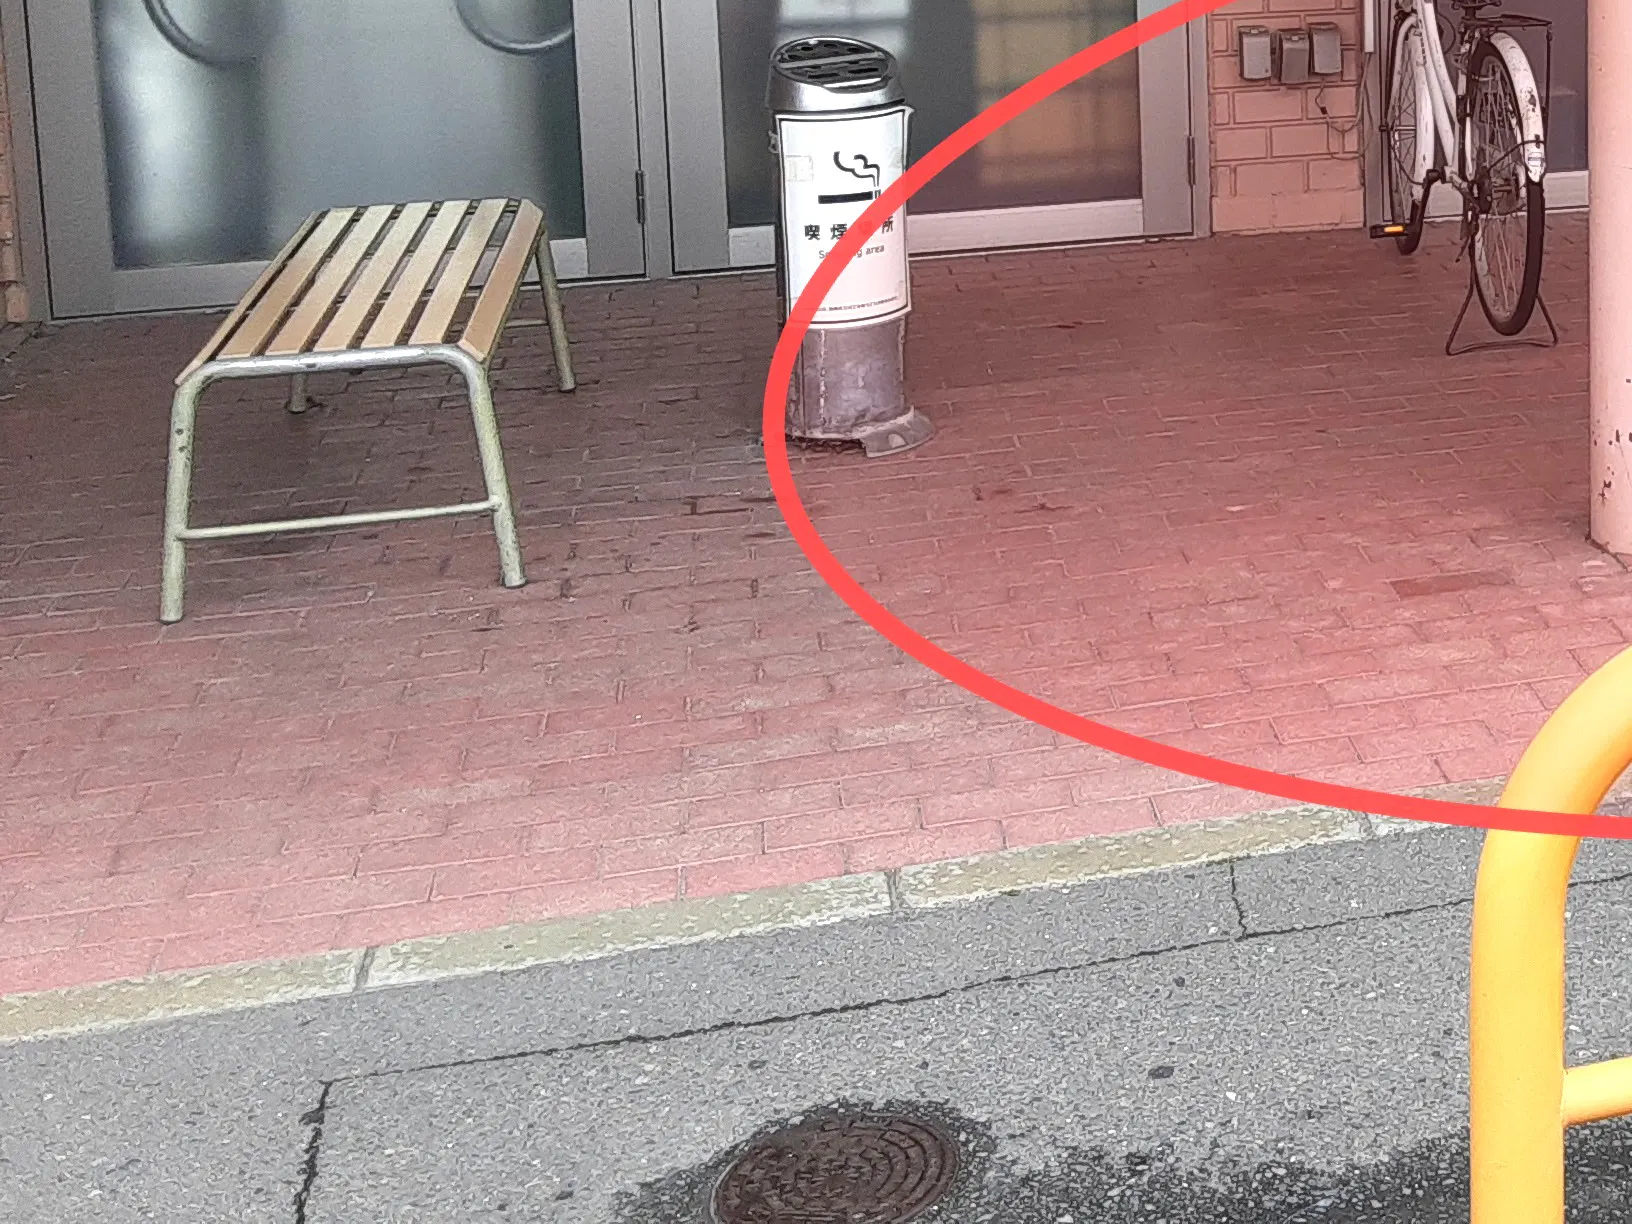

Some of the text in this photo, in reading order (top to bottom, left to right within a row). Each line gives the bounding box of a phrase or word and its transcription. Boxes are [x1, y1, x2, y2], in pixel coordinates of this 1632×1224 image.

[804, 216, 894, 240] 喫煙所
[865, 245, 885, 255] area
